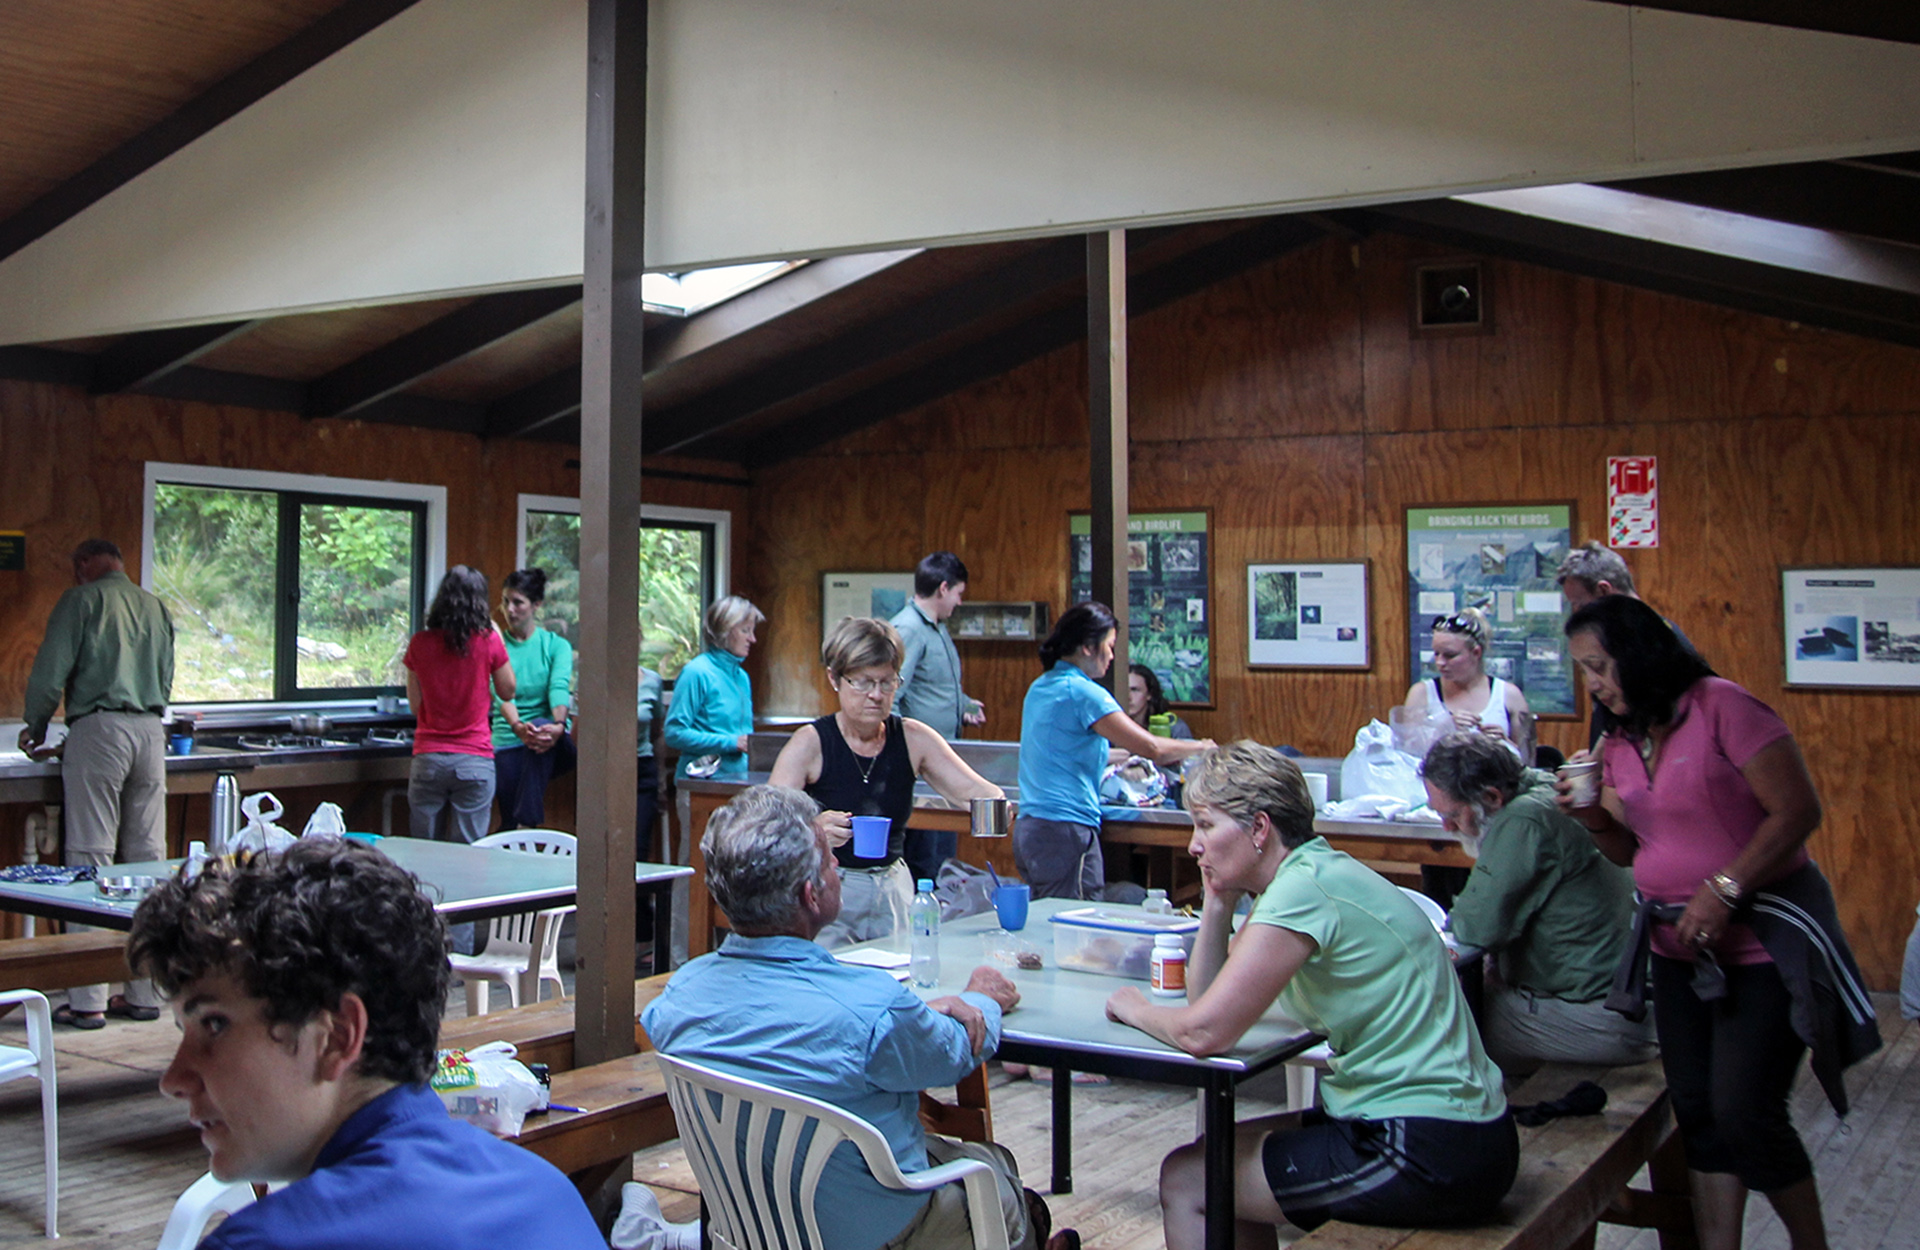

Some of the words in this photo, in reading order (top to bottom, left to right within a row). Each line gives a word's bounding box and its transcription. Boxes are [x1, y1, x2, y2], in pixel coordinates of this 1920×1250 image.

[1145, 519, 1182, 531] BIRDLIFE
[1428, 515, 1473, 527] BRINGING
[1474, 515, 1500, 526] BACK
[1501, 514, 1519, 525] THE
[1520, 513, 1550, 525] BIRDS
